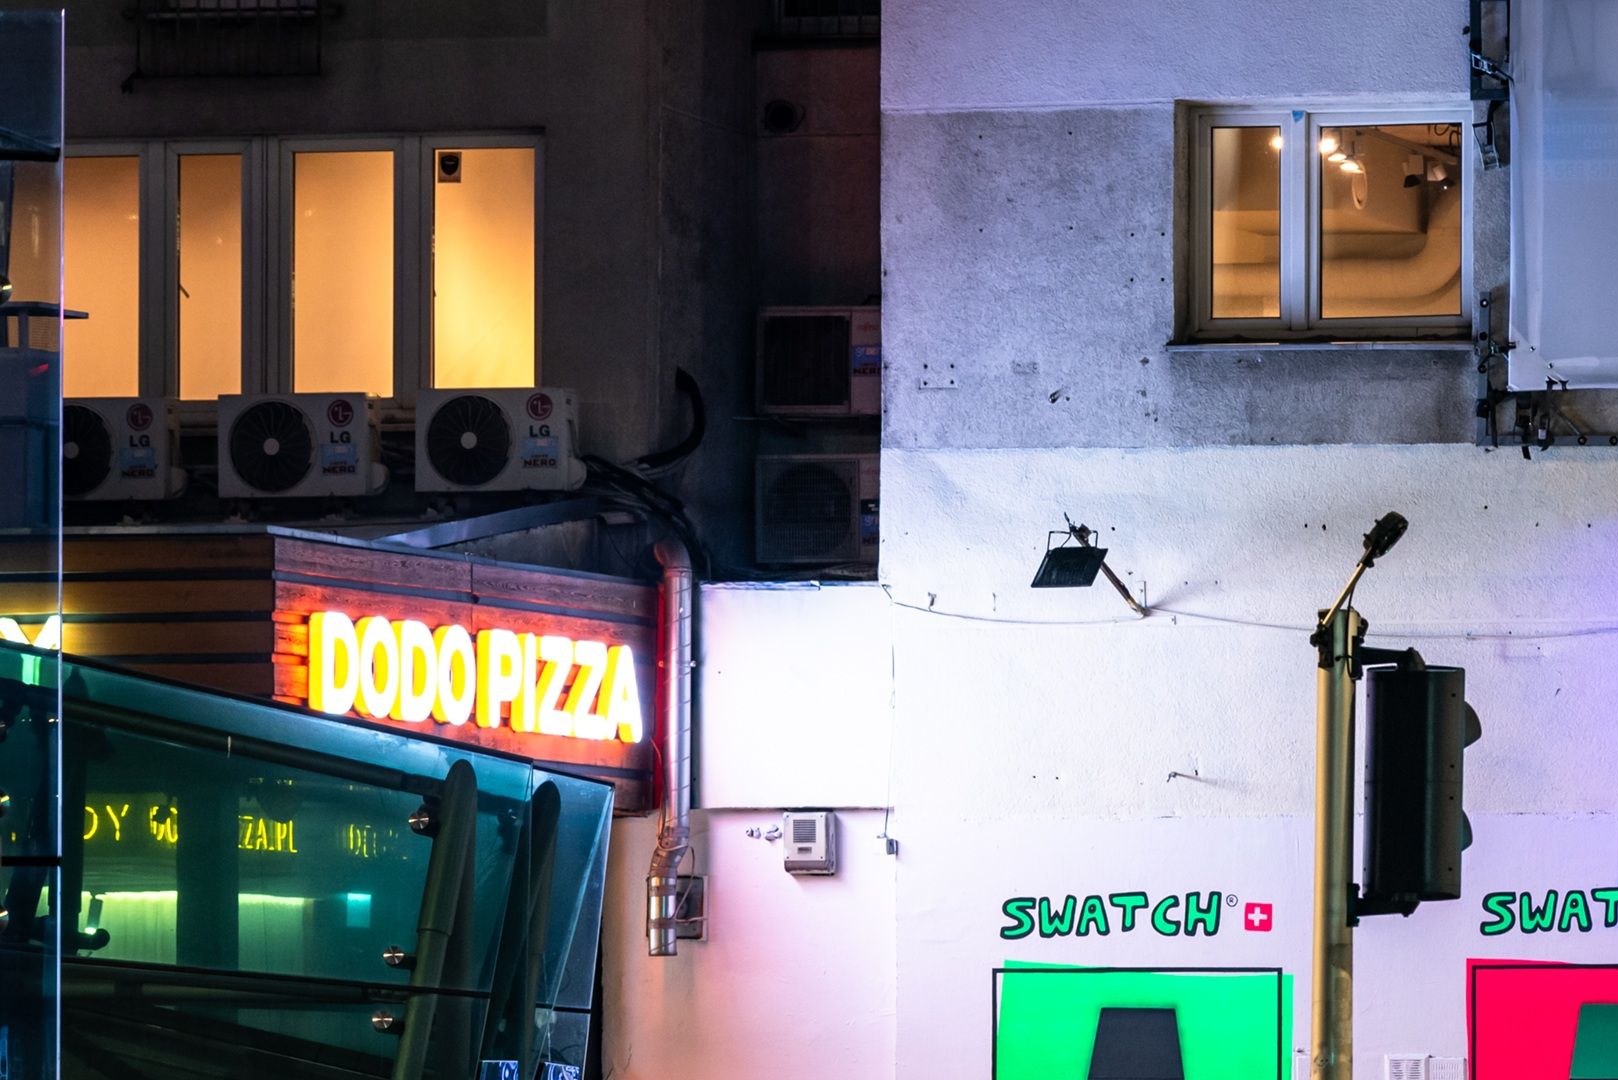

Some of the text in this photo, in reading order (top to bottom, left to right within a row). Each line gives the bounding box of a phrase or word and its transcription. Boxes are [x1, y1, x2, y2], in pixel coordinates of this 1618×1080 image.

[330, 431, 350, 443] LG
[529, 425, 550, 437] LG
[129, 435, 149, 447] LG
[523, 458, 556, 468] NERO
[308, 611, 643, 743] DODO PIZZA
